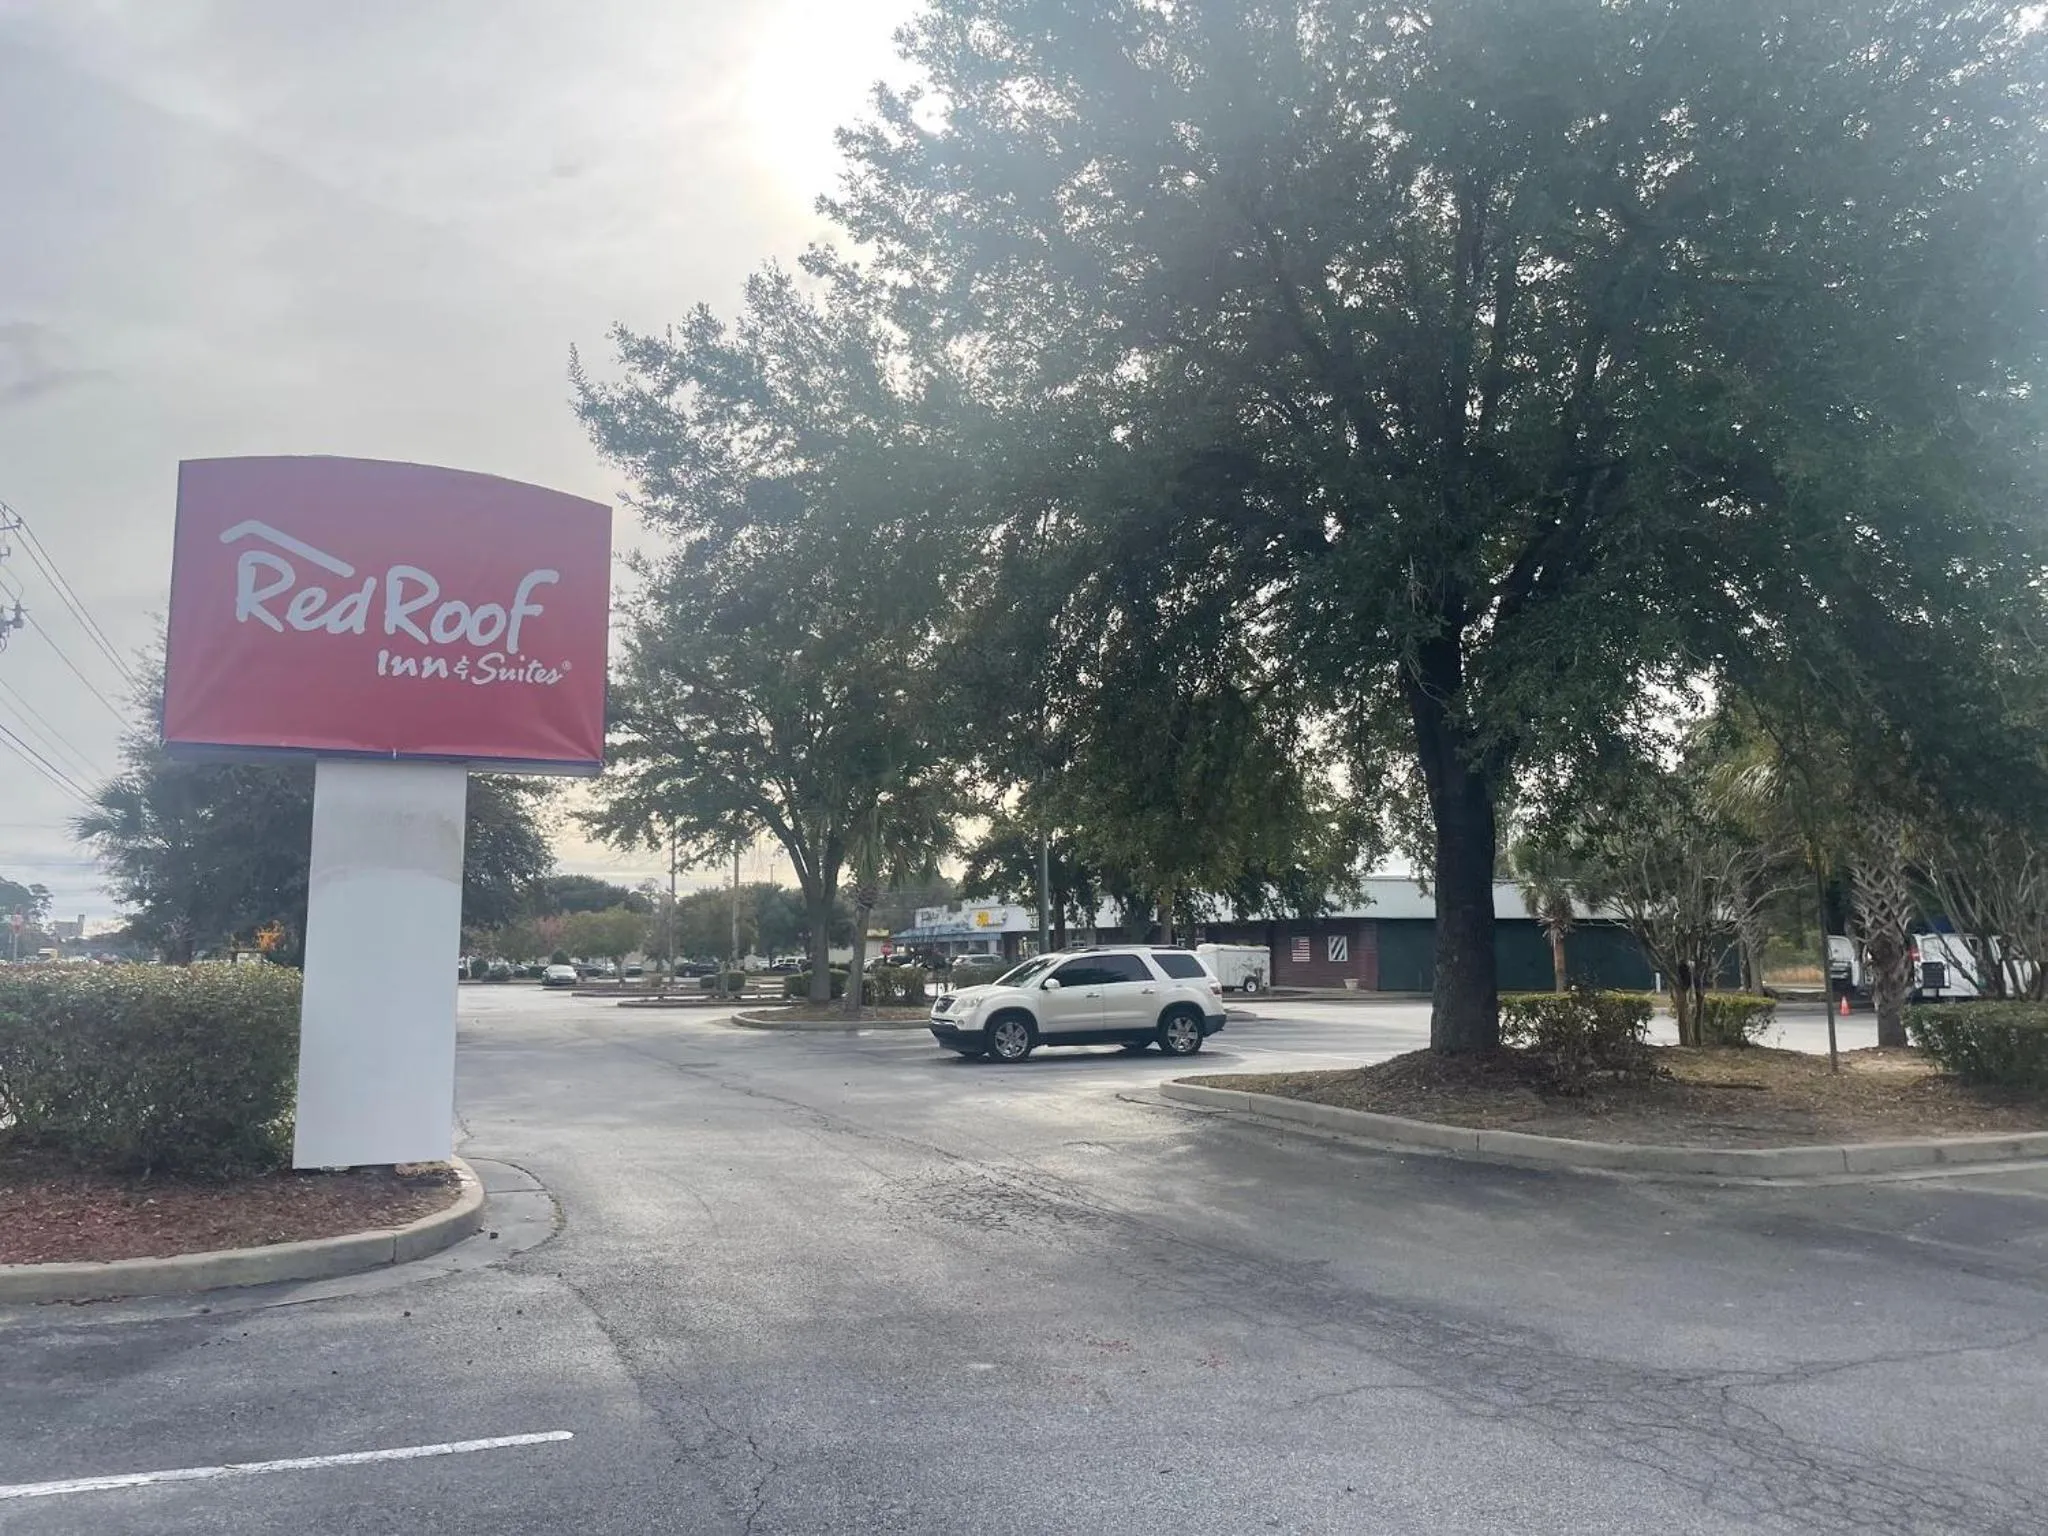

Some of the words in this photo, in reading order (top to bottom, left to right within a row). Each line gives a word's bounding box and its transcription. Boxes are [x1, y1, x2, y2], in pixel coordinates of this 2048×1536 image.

[235, 550, 377, 633] Red
[383, 564, 560, 654] Roof
[377, 650, 449, 678] Inn
[453, 656, 471, 680] &
